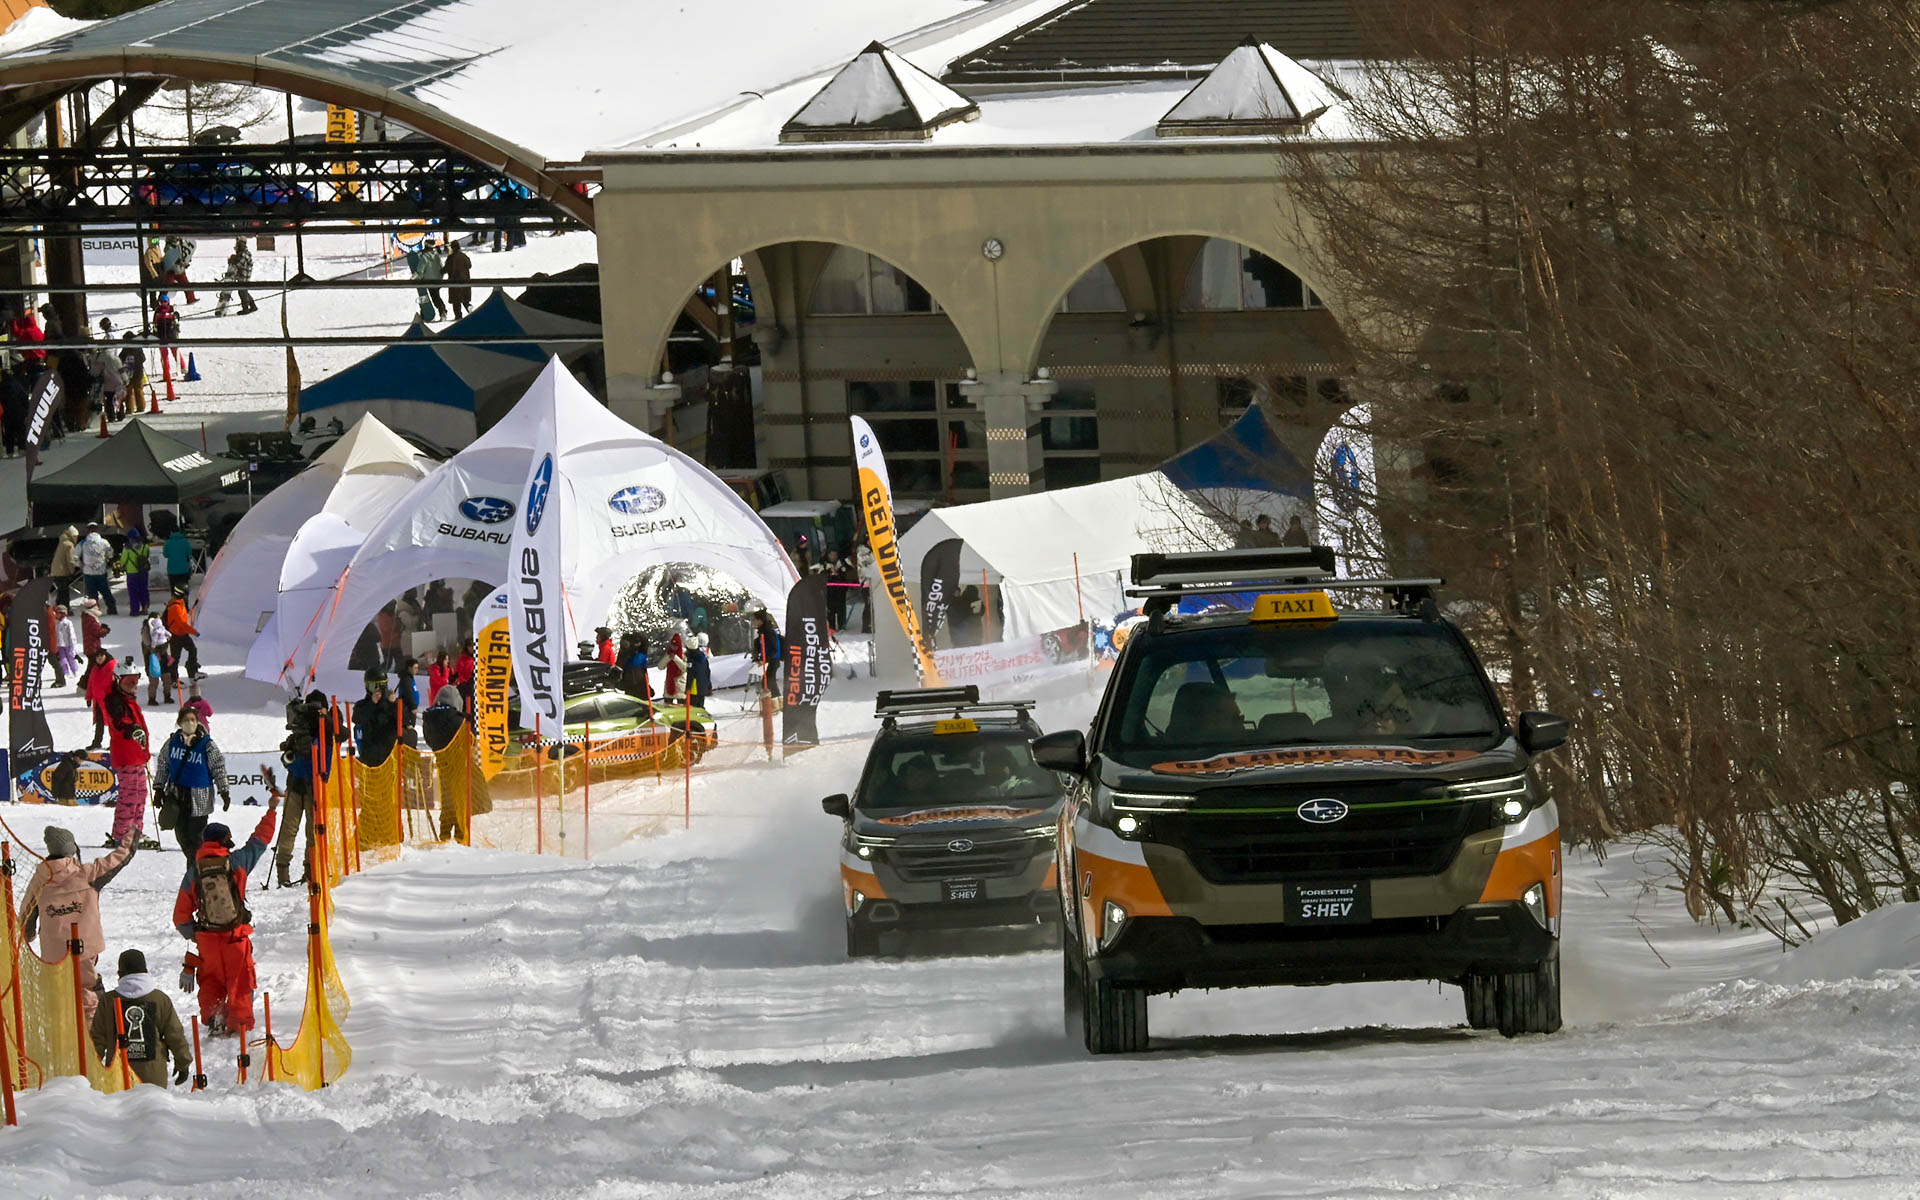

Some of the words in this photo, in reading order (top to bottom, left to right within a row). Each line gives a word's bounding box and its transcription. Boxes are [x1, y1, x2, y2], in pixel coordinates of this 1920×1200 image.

[26, 379, 60, 446] THULE
[220, 469, 240, 487] THULE
[438, 523, 511, 545] SUBARU
[611, 517, 686, 538] SUBARU
[1271, 599, 1315, 613] TAXI
[22, 618, 42, 710] Tsumagoi
[486, 630, 511, 714] GELANDE
[799, 617, 819, 706] Tsumagoi
[12, 647, 26, 710] Palcall
[787, 645, 802, 706] Palcall
[943, 721, 967, 731] TAXI
[170, 747, 202, 764] MEDIA
[1175, 750, 1343, 769] GELANDE
[89, 770, 108, 784] TAXI
[1302, 903, 1352, 917] S:HEV
